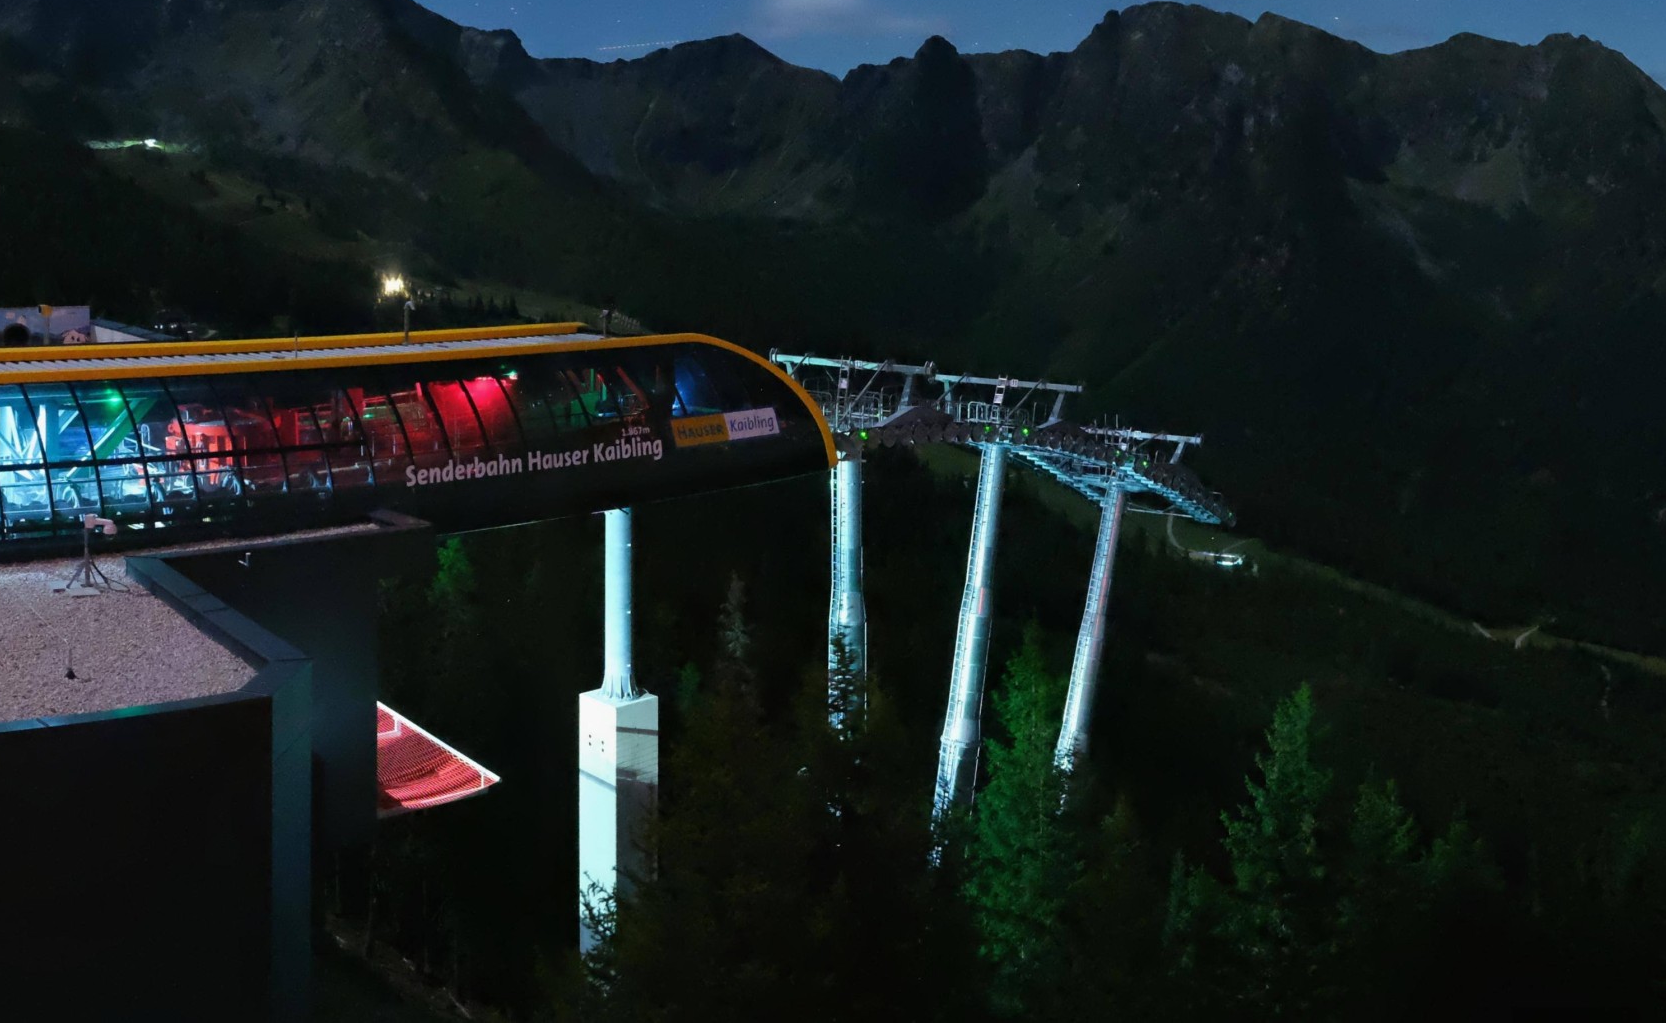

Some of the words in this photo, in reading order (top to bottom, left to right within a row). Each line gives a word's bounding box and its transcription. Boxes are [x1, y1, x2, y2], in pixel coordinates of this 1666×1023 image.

[676, 423, 724, 440] HAUSER
[729, 413, 774, 434] Kaibling
[405, 458, 523, 487] Senderbahn
[528, 447, 589, 471] Hauser
[593, 436, 663, 462] Kaibling
